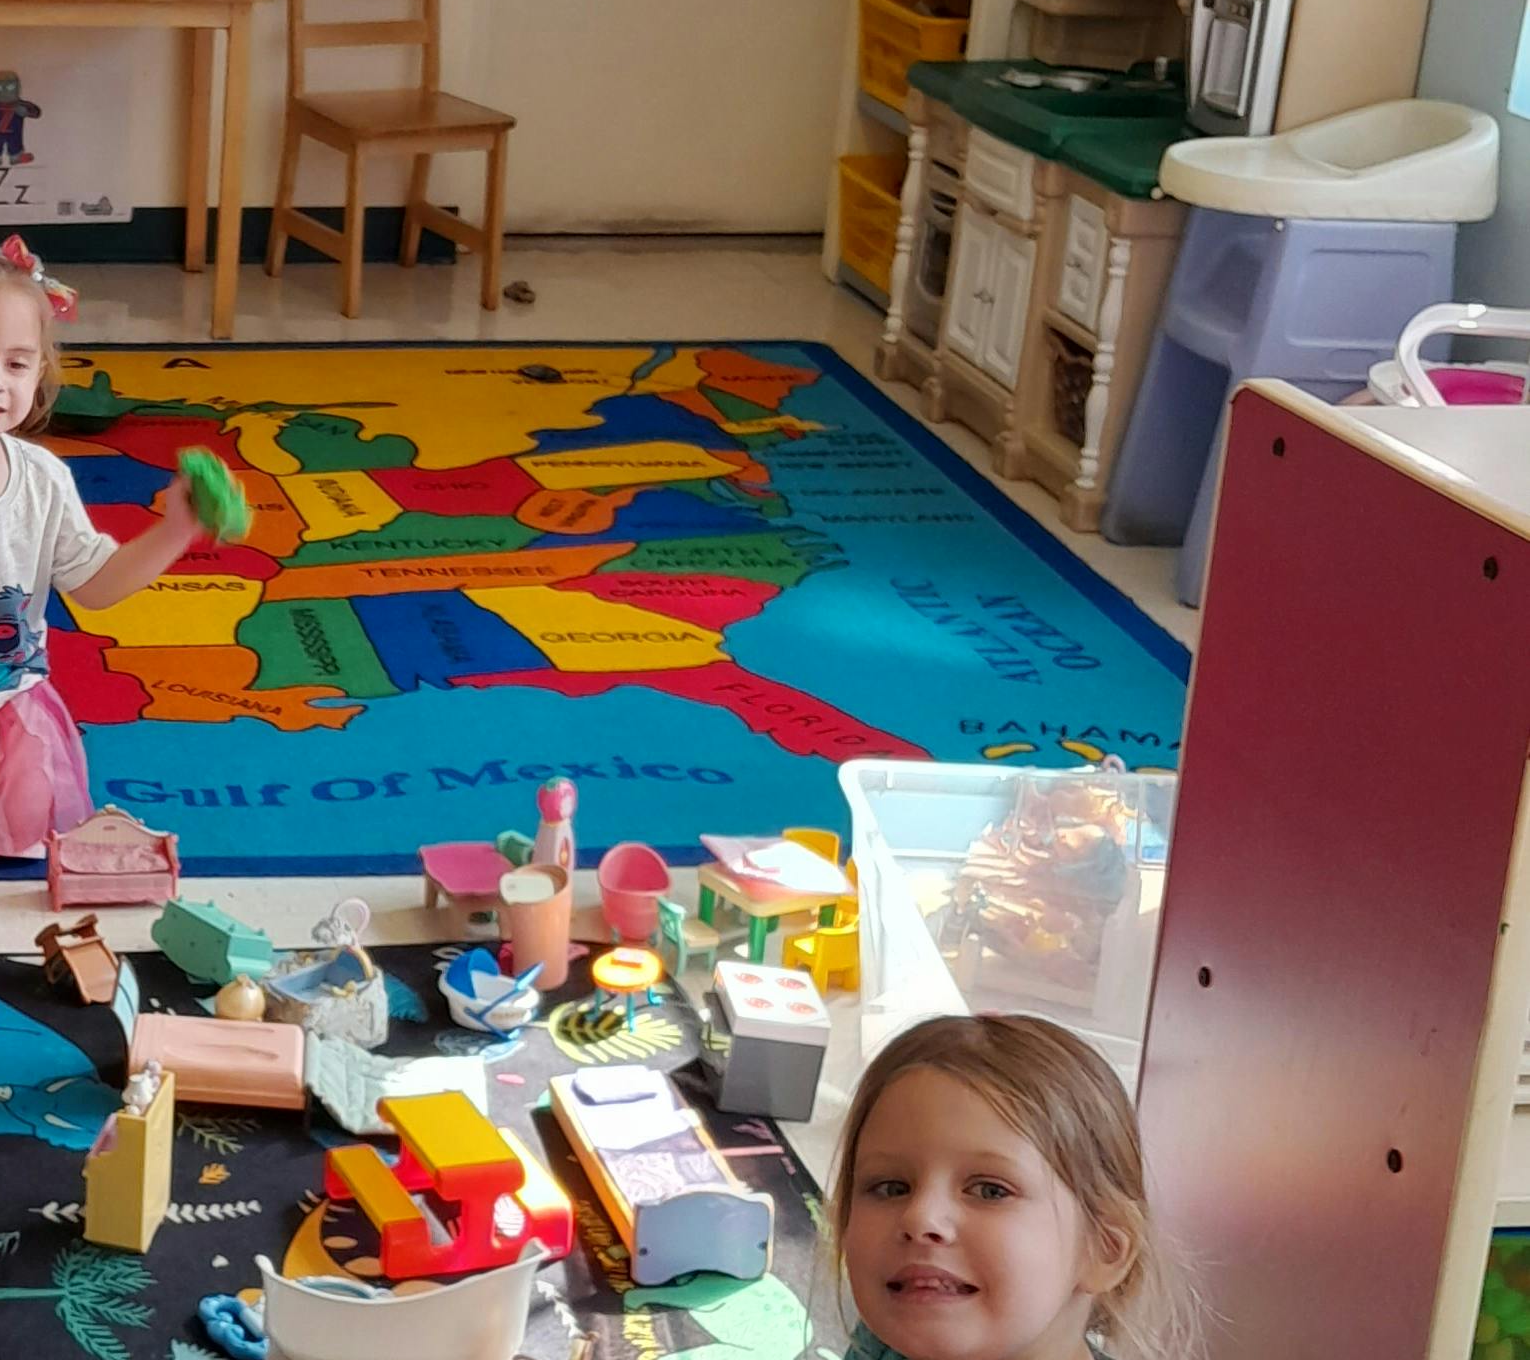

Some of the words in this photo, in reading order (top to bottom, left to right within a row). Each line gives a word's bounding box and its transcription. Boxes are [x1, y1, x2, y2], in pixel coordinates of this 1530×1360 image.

[413, 480, 491, 491] OHIO
[328, 535, 508, 552] KENTUCKY
[645, 546, 764, 558] NORTH
[629, 557, 799, 569] CAROLINA
[361, 566, 556, 580] TENNESSEE
[618, 579, 710, 587] SOUTH
[609, 588, 748, 598] CAROLINA
[890, 576, 1044, 685] ATLANTIC
[976, 593, 1102, 672] OCEAN
[540, 631, 705, 644] GEORGIA
[152, 678, 283, 717] LOUISIANA
[105, 777, 291, 808] Gulf
[310, 768, 411, 804] Of
[435, 752, 734, 793] Mexico
